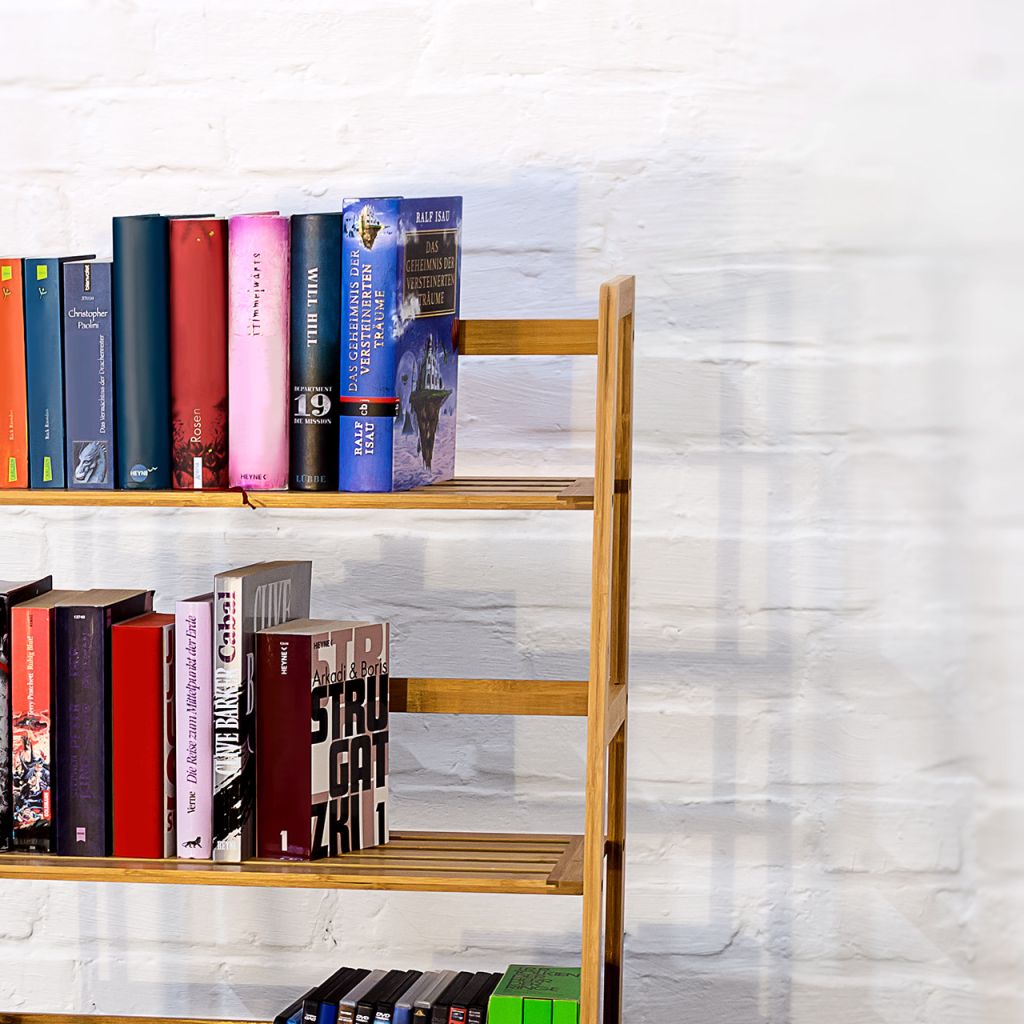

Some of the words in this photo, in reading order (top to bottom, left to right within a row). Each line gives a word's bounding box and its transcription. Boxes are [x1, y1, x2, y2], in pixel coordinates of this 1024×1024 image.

[416, 212, 432, 223] RALF
[435, 211, 450, 222] ISAU
[426, 241, 439, 254] DAS
[350, 250, 360, 276] DER
[406, 258, 441, 272] GEHEIMNIS
[443, 256, 454, 269] DER
[306, 267, 318, 308] WILL
[406, 275, 455, 290] VERSTEINERTEN
[68, 308, 108, 322] Christopher
[78, 320, 100, 330] Paolini
[348, 280, 360, 362] GEHEIMNIS
[360, 264, 372, 375] VERSTEINERTEN
[374, 290, 385, 348] TRÄUME
[306, 314, 318, 347] HILL
[348, 364, 358, 392] DAS
[293, 393, 332, 418] 19
[359, 399, 368, 415] cbj
[190, 408, 200, 443] Rosen
[354, 421, 363, 456] RALF
[366, 422, 375, 454] ISAU
[296, 472, 326, 482] LÜBBE
[186, 616, 197, 638] Erde
[218, 591, 236, 663] Cabal
[27, 652, 35, 670] Ruhig
[186, 639, 197, 657] der
[312, 664, 346, 687] Arkadi
[349, 662, 357, 679] &
[361, 658, 388, 677] Boris
[186, 659, 200, 715] Mittelpunkt
[215, 668, 240, 730] BARKER
[188, 716, 198, 740] zum
[186, 740, 198, 766] Reise
[215, 732, 241, 775] CLIVE
[186, 767, 197, 784] Die
[187, 792, 196, 814] Verne
[376, 802, 385, 846] 1
[280, 830, 288, 852] 1
